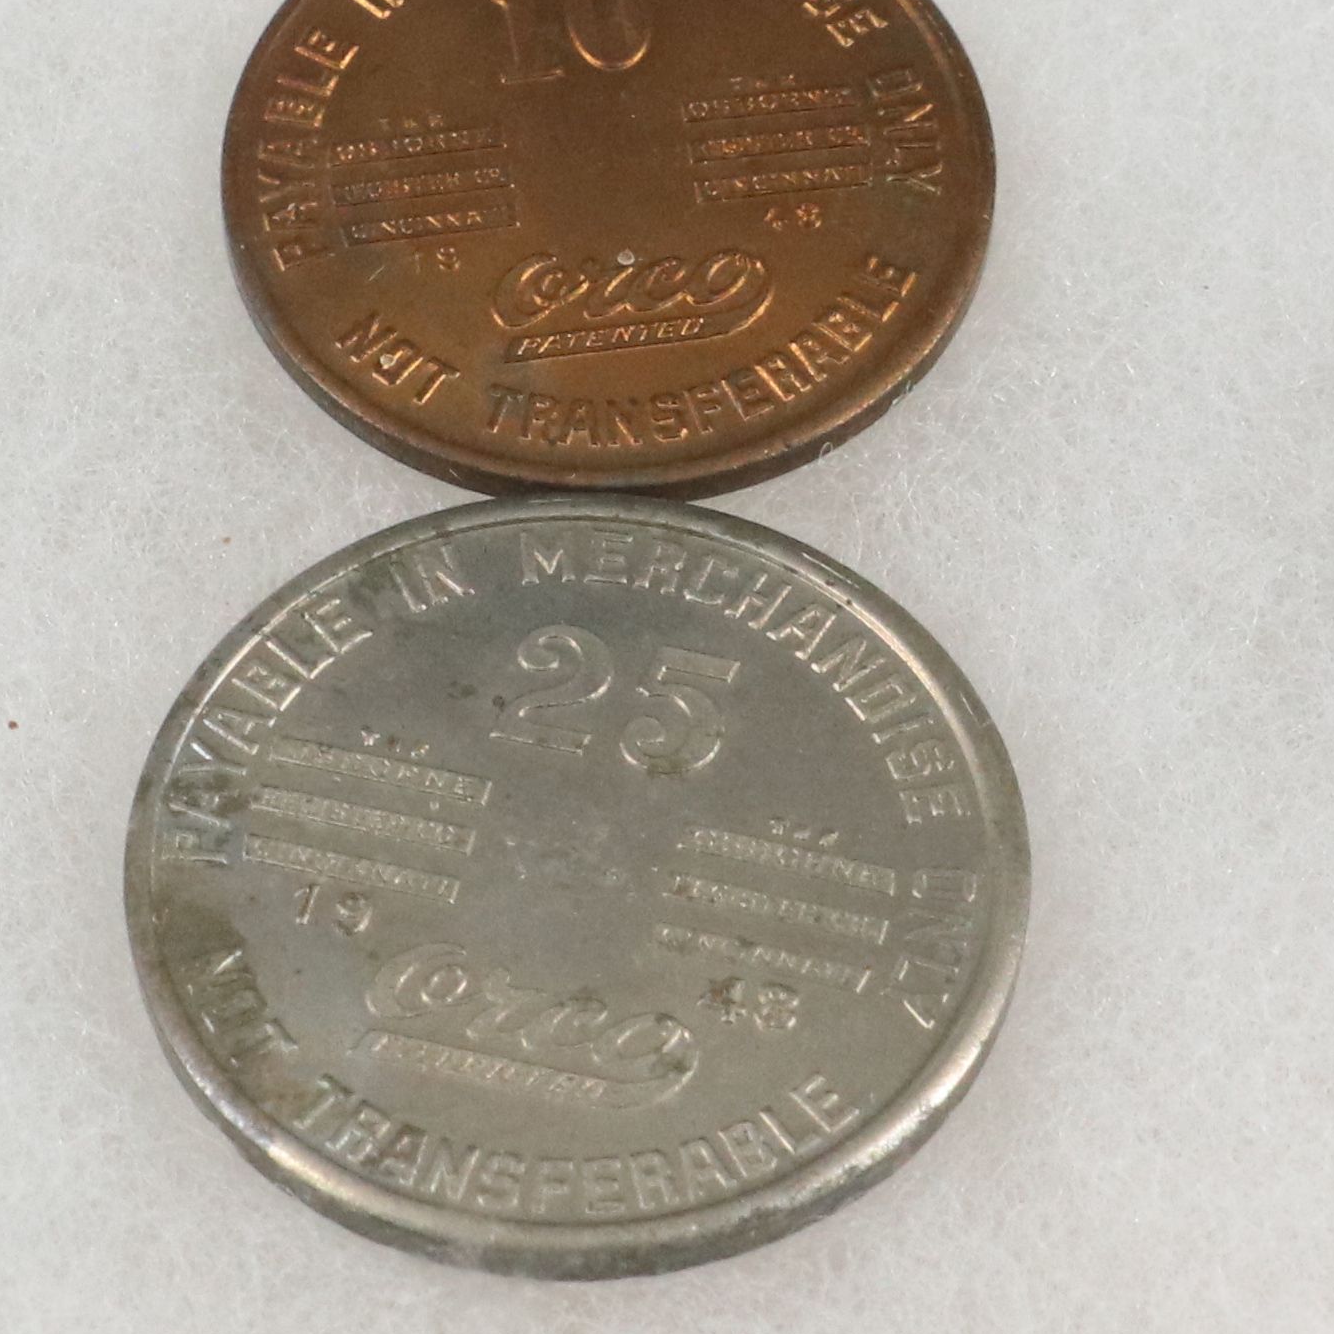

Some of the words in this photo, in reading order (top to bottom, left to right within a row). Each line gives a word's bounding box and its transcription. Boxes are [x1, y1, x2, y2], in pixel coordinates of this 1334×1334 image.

[257, 30, 360, 272] PAYABLE
[869, 70, 943, 197] ONLY
[334, 313, 460, 405] NOT
[486, 255, 918, 448] TRANSFERABLE
[516, 316, 704, 356] PATENTED
[160, 598, 374, 865] PAYABLE
[387, 544, 477, 613] IN
[519, 530, 971, 826] MERCHANDISE
[487, 623, 741, 777] 25
[293, 882, 374, 937] 19
[292, 1072, 861, 1217] TRANSFERABLE
